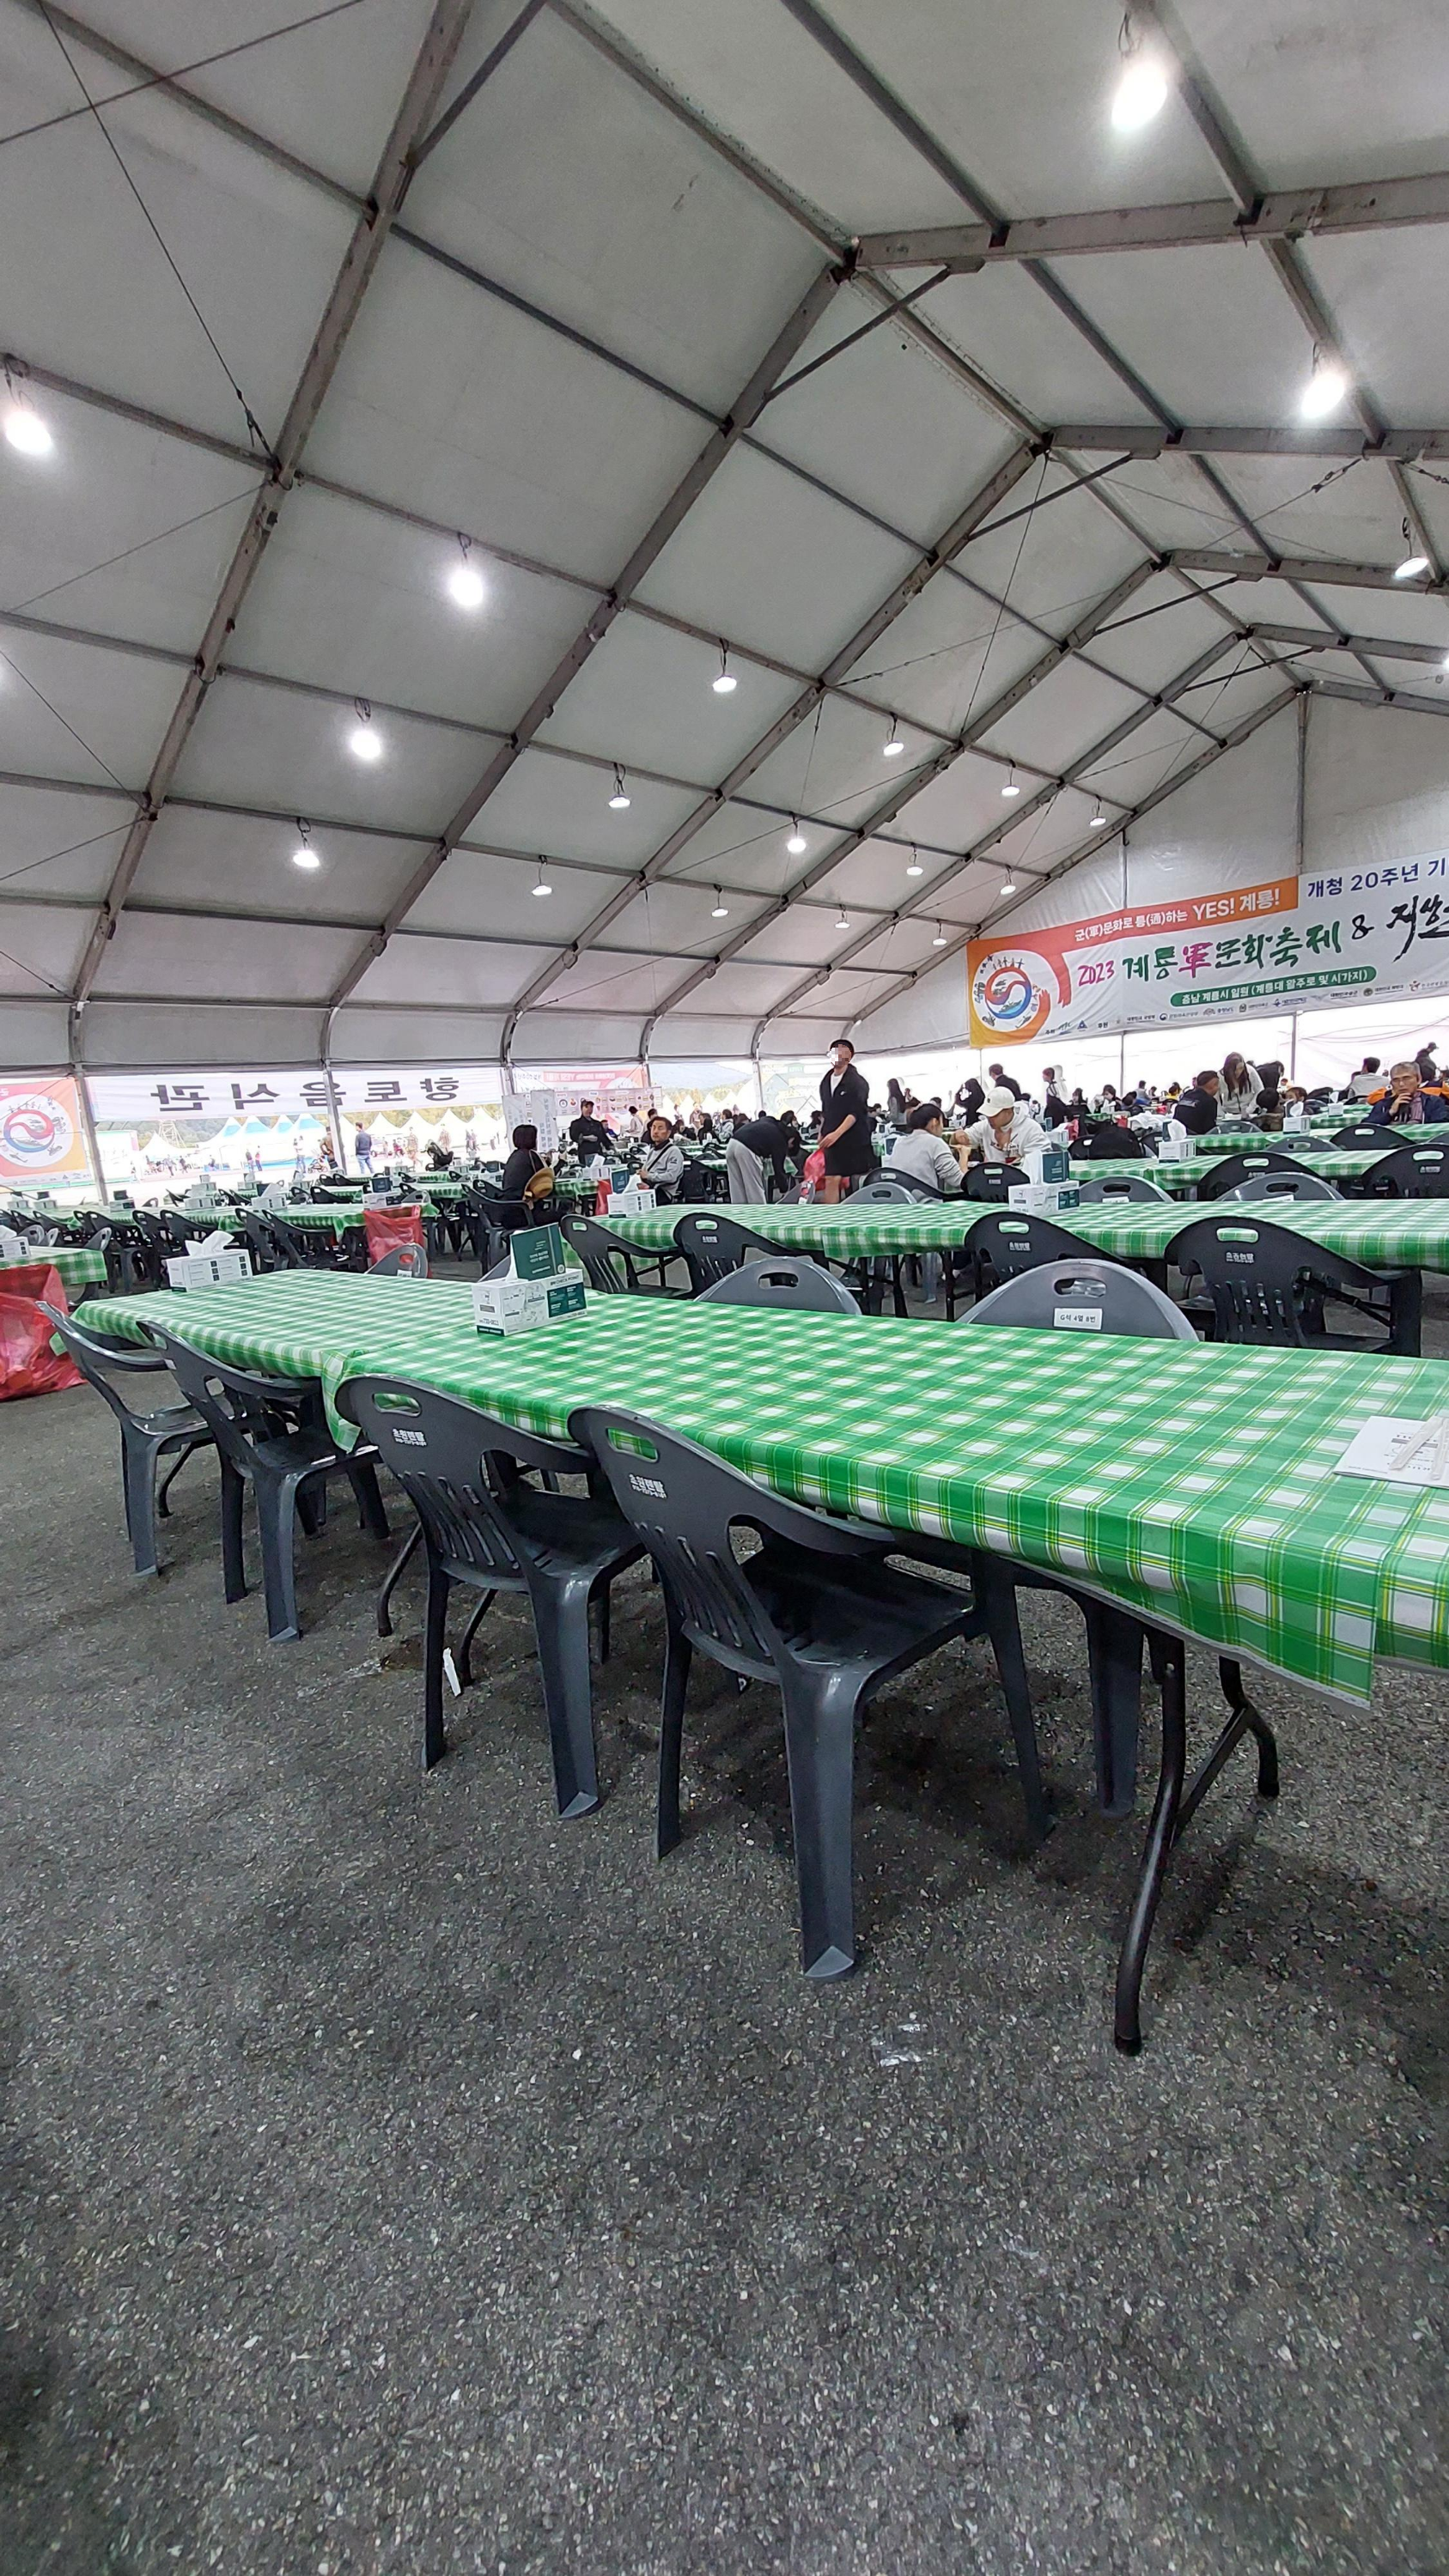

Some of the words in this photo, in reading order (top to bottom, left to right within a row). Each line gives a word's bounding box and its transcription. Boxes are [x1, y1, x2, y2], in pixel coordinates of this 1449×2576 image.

[1307, 877, 1343, 898] 개청
[1350, 862, 1419, 891] 20주년
[1192, 900, 1236, 921] YES!
[1239, 888, 1281, 913] 계룡!
[1076, 959, 1116, 987] 2023
[1351, 914, 1375, 940] &
[1181, 992, 1202, 1005] 충남
[1202, 989, 1230, 1003] 계룡시
[1231, 987, 1250, 999] 일원
[1251, 980, 1285, 995] (계룡대
[1318, 973, 1330, 986] 및
[1330, 969, 1368, 985] 시가지)
